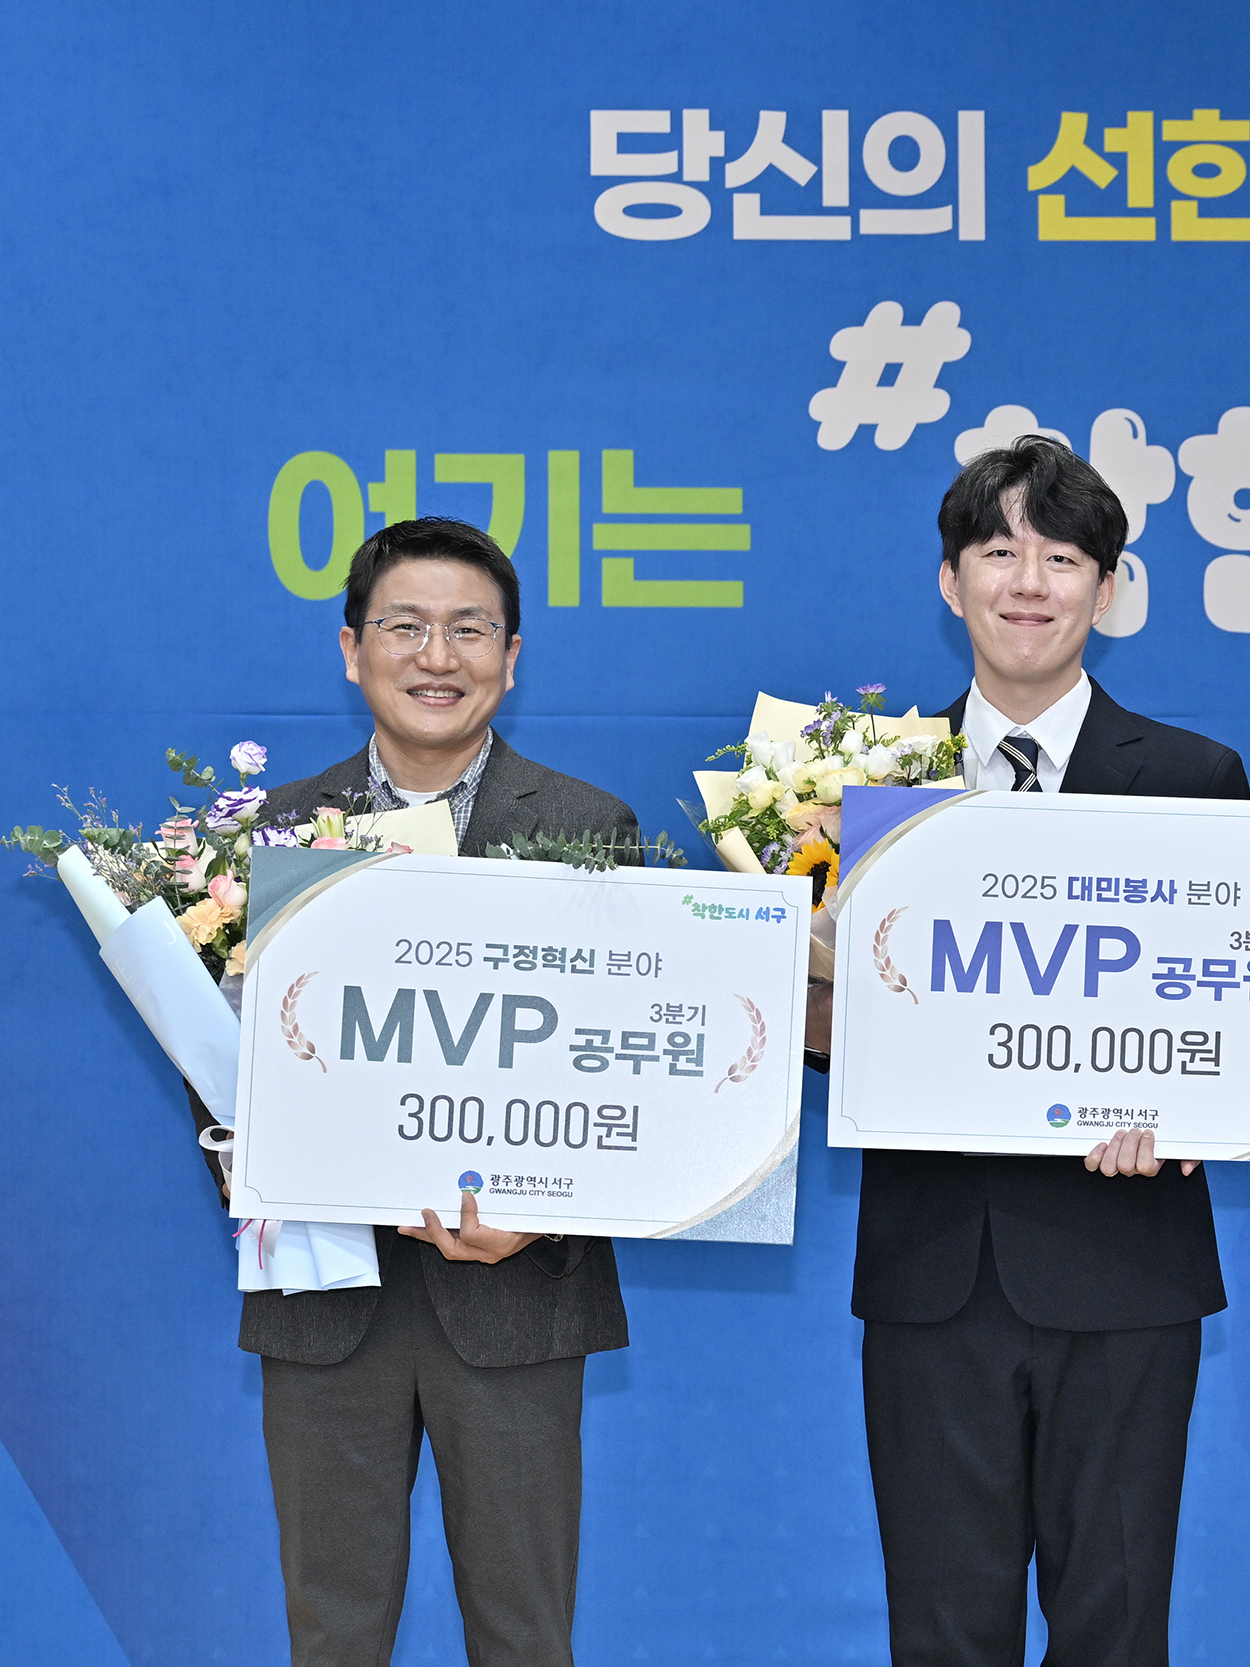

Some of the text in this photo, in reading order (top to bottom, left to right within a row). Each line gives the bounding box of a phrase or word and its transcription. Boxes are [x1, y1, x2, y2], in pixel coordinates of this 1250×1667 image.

[590, 108, 986, 241] 당신의
[268, 449, 751, 607] 여기는
[982, 873, 1241, 907] 2025 대민봉사 분야
[682, 895, 787, 923] #착한도시 서구
[395, 939, 662, 978] 2025 구정혁신 분야
[931, 919, 1141, 997] MVP
[340, 985, 705, 1077] MVP 공무원
[650, 1003, 706, 1026] 3분기
[988, 1023, 1221, 1076] 300,000원
[398, 1093, 639, 1151] 300,000원
[1077, 1120, 1113, 1128] GWANGJU
[1078, 1107, 1159, 1121] 광주광역시 서구
[489, 1188, 527, 1196] GWANGJU
[490, 1174, 574, 1189] 광주광역시 서구
